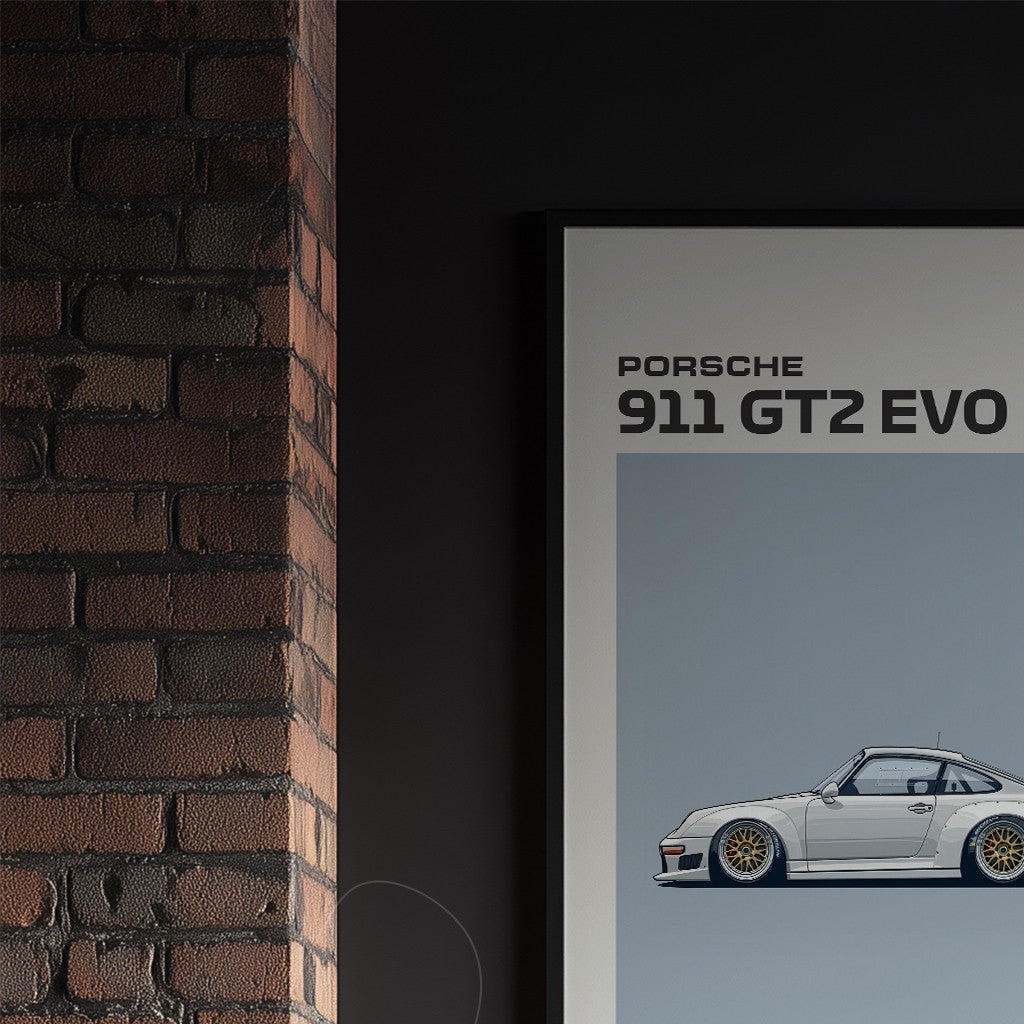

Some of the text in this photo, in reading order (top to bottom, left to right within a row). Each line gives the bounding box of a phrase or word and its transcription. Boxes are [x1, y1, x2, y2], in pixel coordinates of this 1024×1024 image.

[618, 355, 804, 377] PORSCHE
[618, 388, 1008, 435] 911 GT2 EVO
